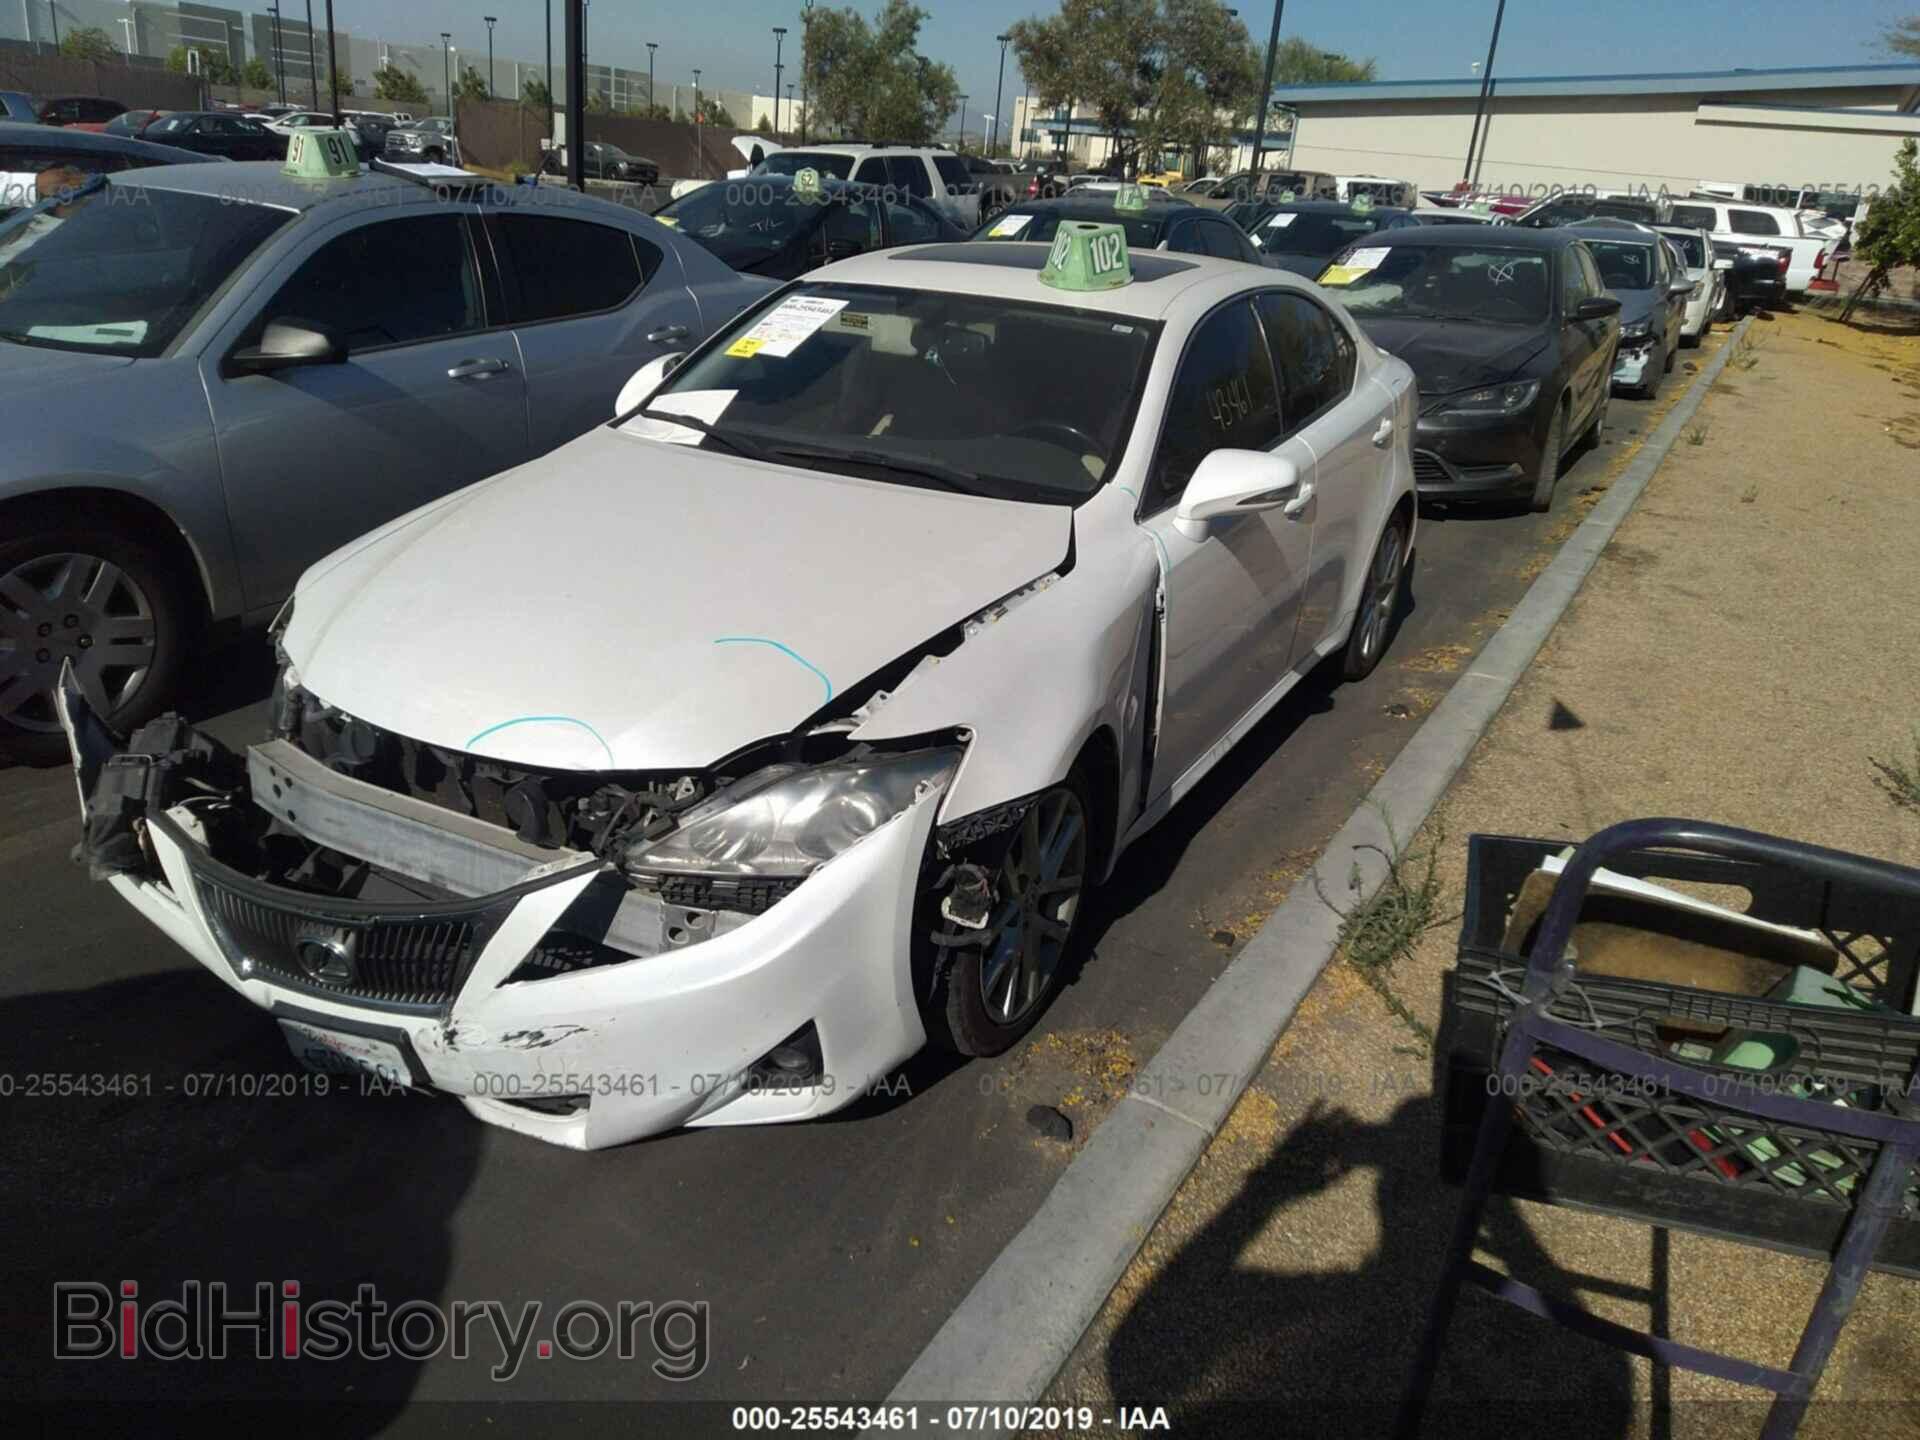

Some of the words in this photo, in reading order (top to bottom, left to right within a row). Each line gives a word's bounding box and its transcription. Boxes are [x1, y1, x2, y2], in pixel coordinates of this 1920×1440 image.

[292, 135, 304, 163] 91
[327, 136, 350, 164] 91
[1089, 232, 1123, 274] 102
